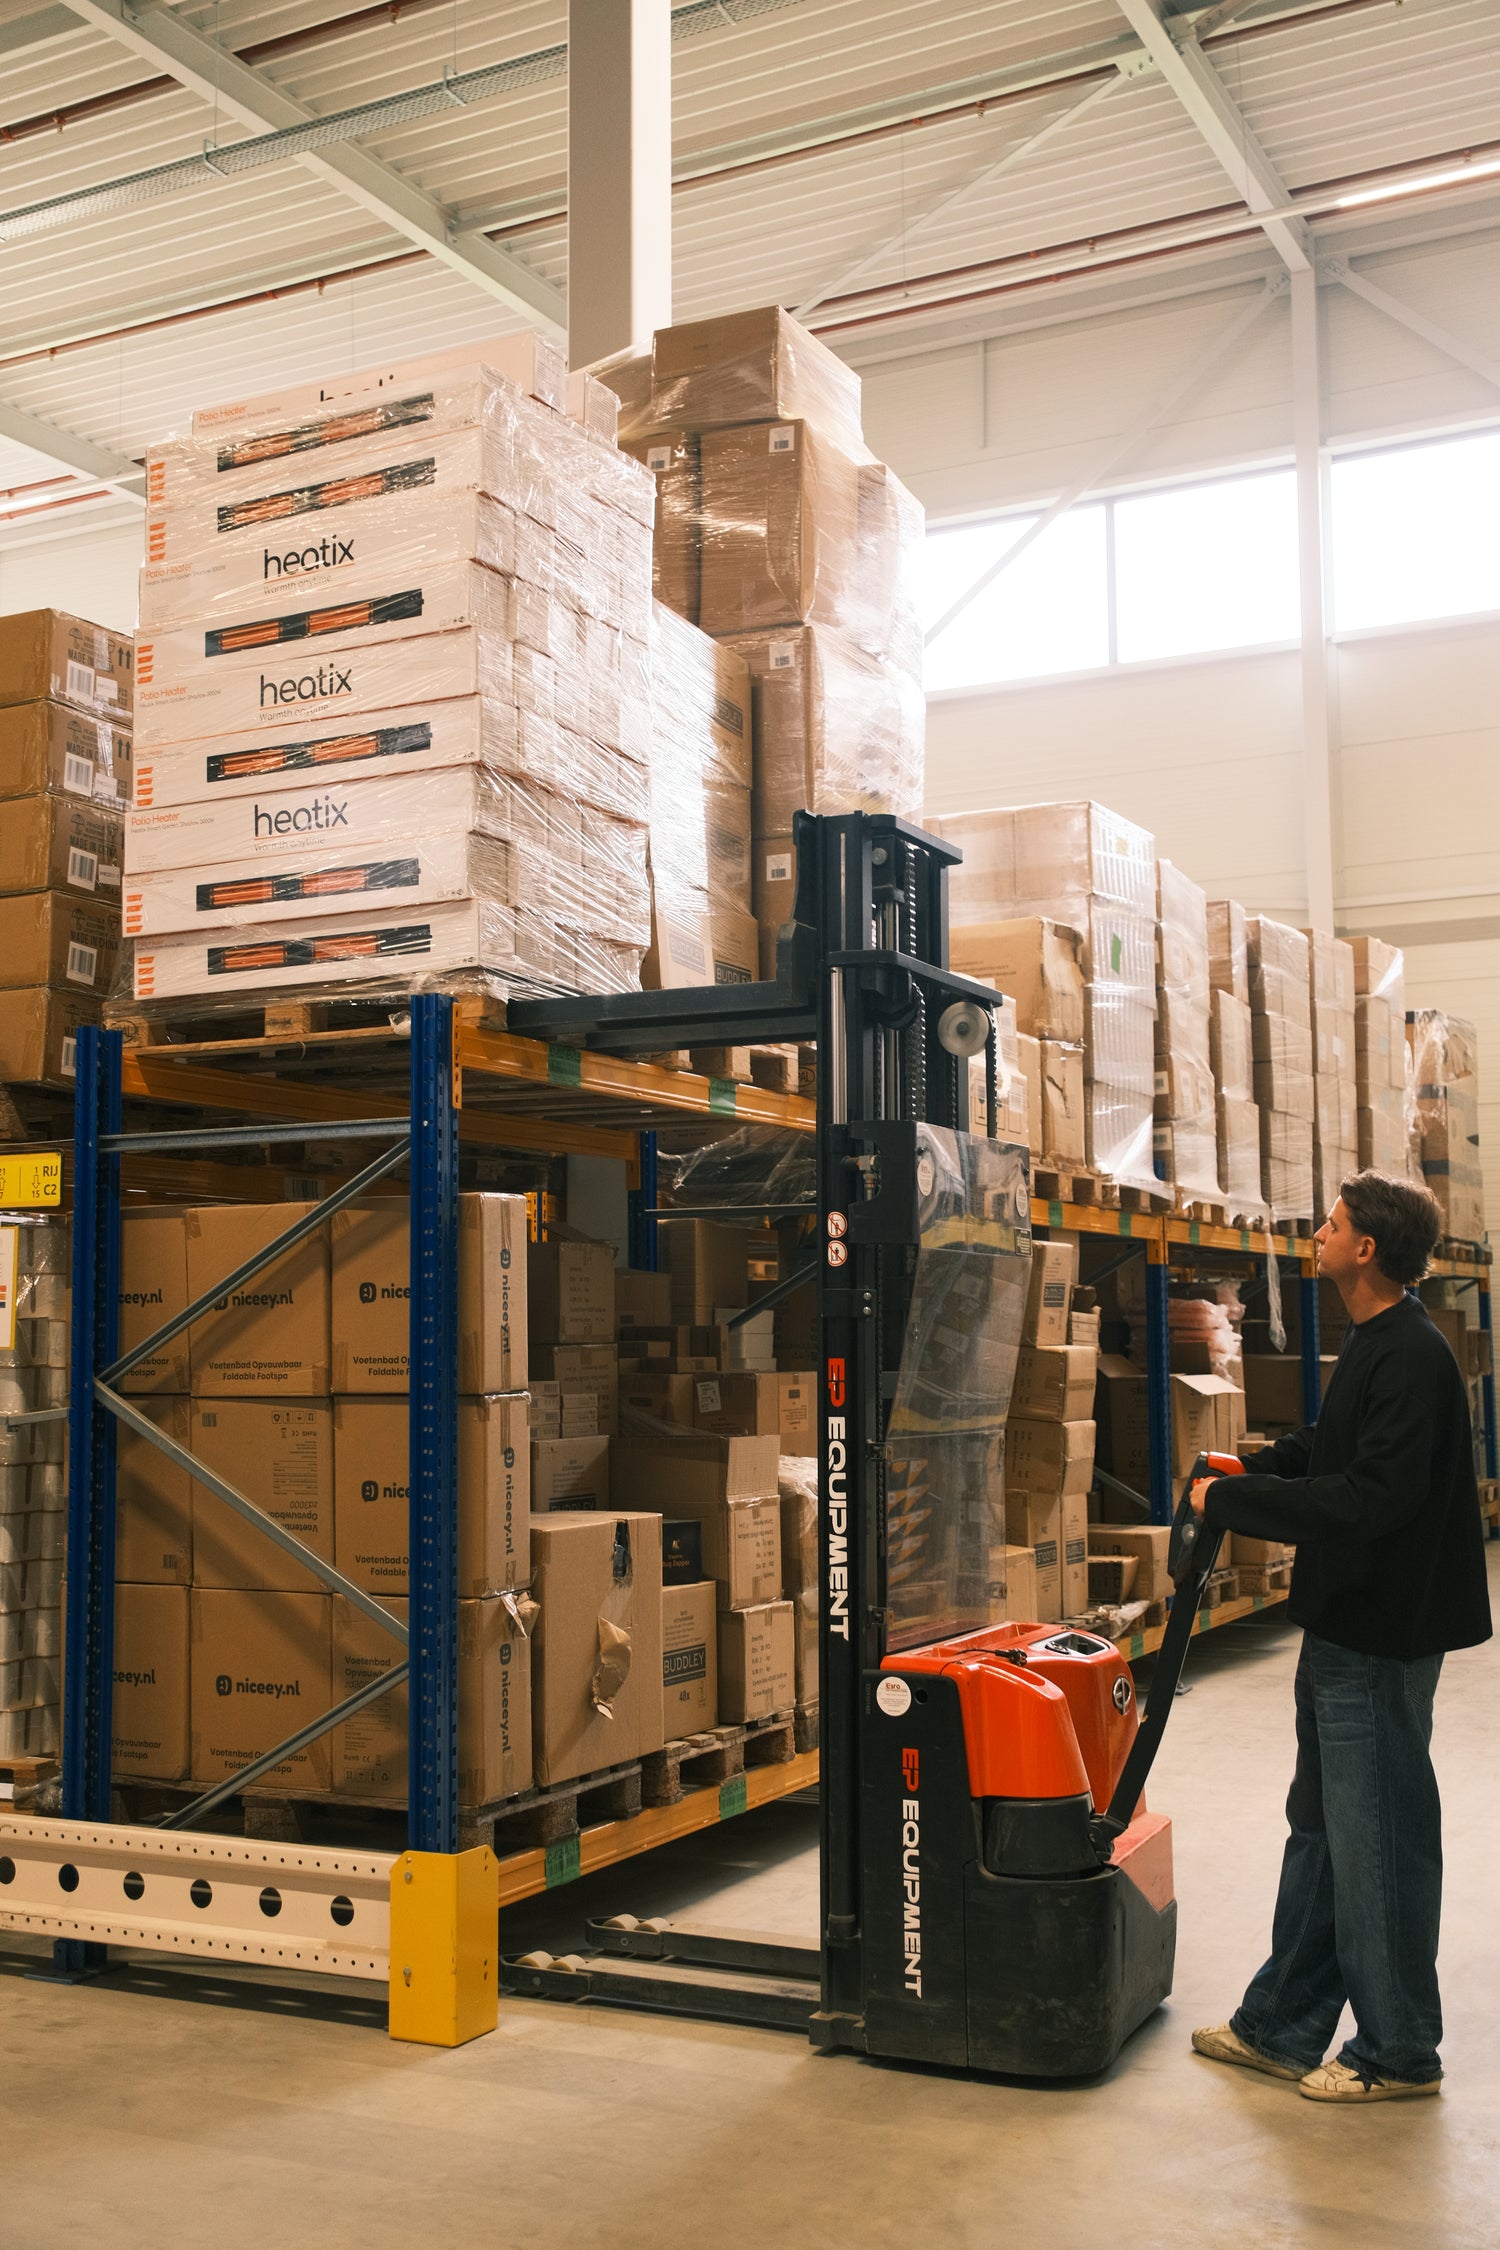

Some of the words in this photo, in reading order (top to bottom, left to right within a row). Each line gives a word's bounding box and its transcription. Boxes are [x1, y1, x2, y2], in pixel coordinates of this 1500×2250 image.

[264, 534, 355, 579] heatix
[263, 581, 297, 595] Warmth
[297, 574, 333, 592] anytime
[68, 648, 85, 664] MADE
[161, 686, 188, 697] Heater
[260, 663, 352, 707] heatix
[259, 709, 293, 722] Warmth
[294, 702, 329, 718] anytime
[66, 741, 85, 757] MADE
[131, 816, 151, 826] Patio
[152, 812, 180, 824] Heater
[254, 795, 349, 838] heatix
[70, 835, 88, 850] MADE
[90, 842, 97, 852] IN
[98, 843, 117, 859] CHINA
[254, 840, 289, 852] Warmth
[289, 836, 326, 849] anytime
[71, 930, 89, 944] MADE
[91, 936, 98, 947] IN
[98, 938, 118, 951] CHINA
[34, 1166, 38, 1174] 1
[43, 1165, 58, 1177] RIJ
[32, 1190, 40, 1198] 15
[43, 1184, 57, 1196] C2
[118, 1288, 163, 1308] ceey.nl
[232, 1289, 294, 1309] niceey.nl
[501, 1274, 511, 1355] niceey.nl
[208, 1361, 250, 1370] Voetenbad
[252, 1360, 302, 1371] Opvouwbaar
[353, 1355, 399, 1365] Voetenbad
[222, 1371, 256, 1380] Foldable
[257, 1371, 288, 1382] Footspa
[368, 1367, 404, 1376] Foldable
[827, 1358, 845, 1407] EP
[268, 1510, 318, 1521] Opvouwbaa
[504, 1474, 514, 1556] niceey.nl
[282, 1522, 318, 1533] Voetenb
[828, 1416, 849, 1642] EQUIPMENT
[355, 1555, 401, 1565] Voetenbad
[673, 1559, 690, 1567] Zapper
[370, 1567, 406, 1577] Foldable
[344, 1656, 391, 1667] Voetenbad
[663, 1652, 705, 1674] BUDDLEY
[113, 1669, 156, 1687] ceey.nl
[236, 1678, 300, 1699] niceey.nl
[679, 1690, 690, 1702] 48x
[500, 1670, 512, 1754] niceey.nl
[115, 1738, 162, 1750] Opvouwbaar
[119, 1750, 148, 1761] Footspa
[210, 1747, 253, 1759] Voetenbad
[902, 1748, 919, 1792] EP
[902, 1799, 922, 2000] EQUIPMENT
